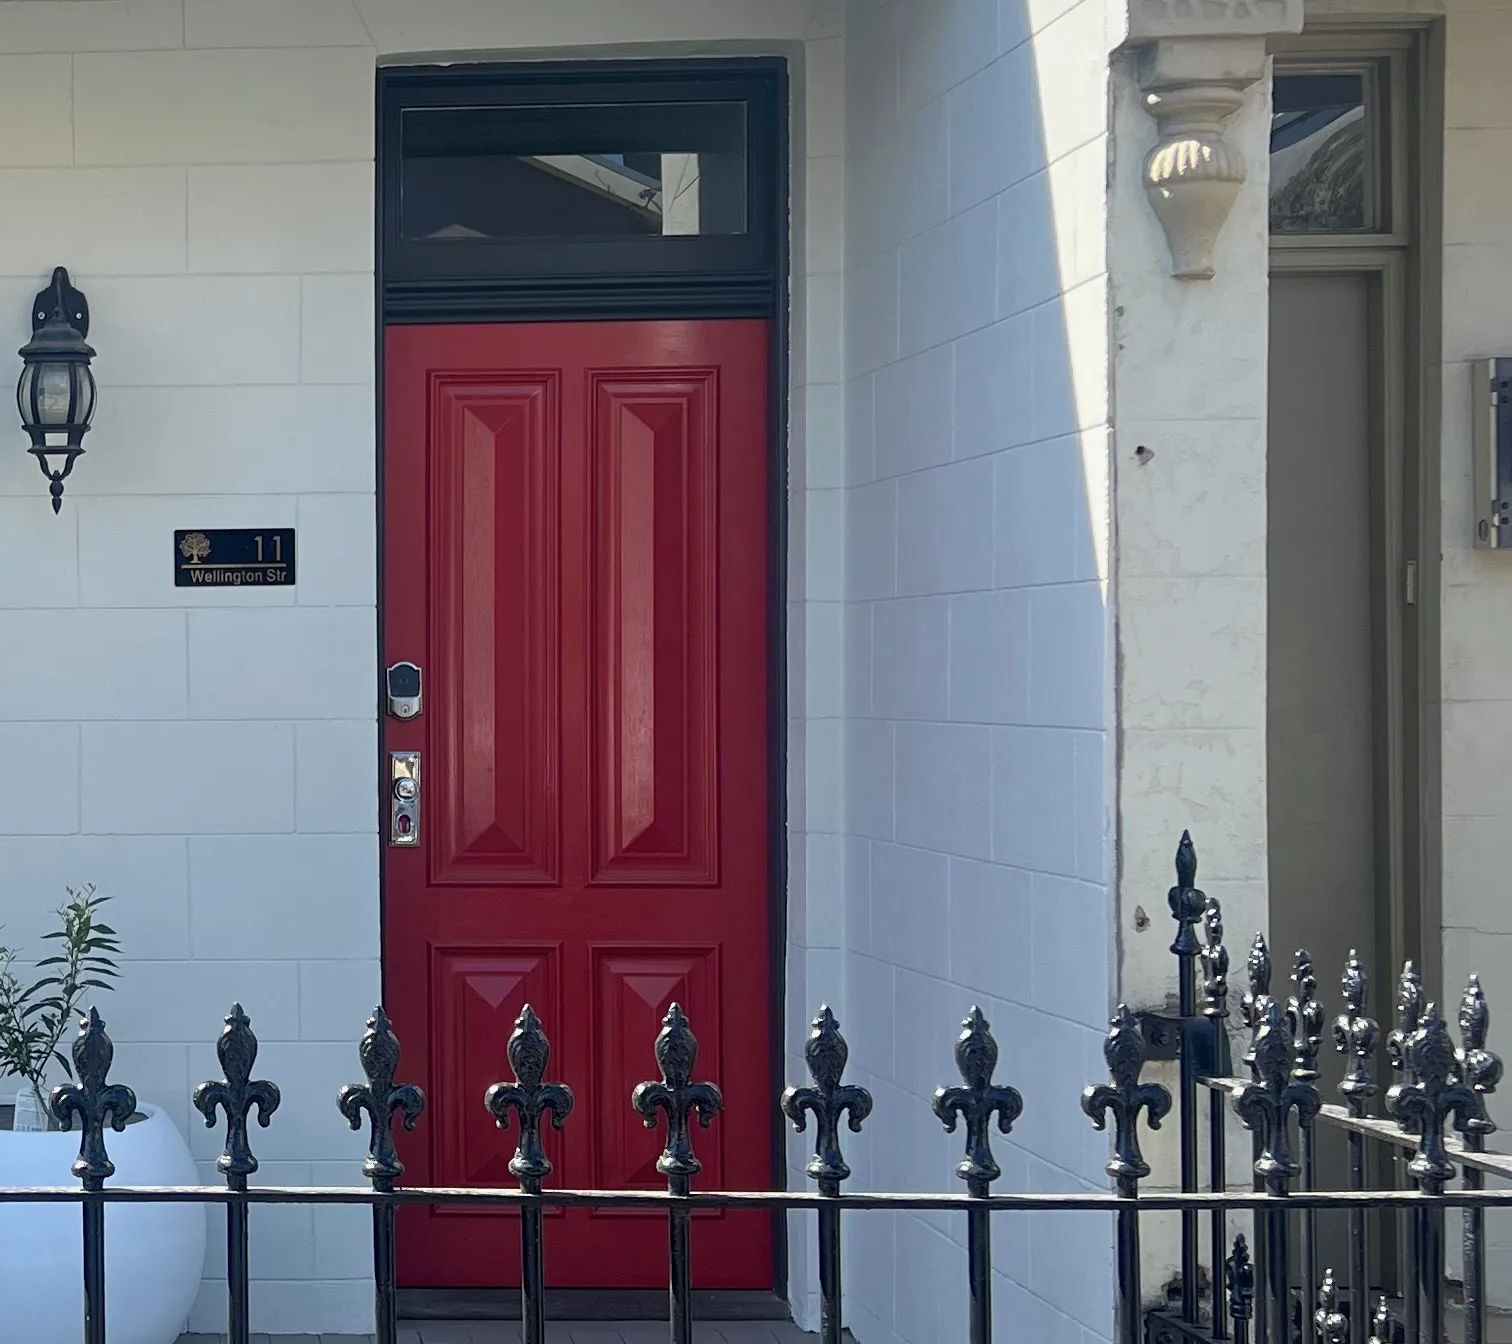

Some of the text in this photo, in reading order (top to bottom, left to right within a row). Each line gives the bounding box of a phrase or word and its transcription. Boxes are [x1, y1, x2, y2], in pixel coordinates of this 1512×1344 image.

[254, 535, 281, 562] 11
[190, 569, 287, 585] Wellington Str
